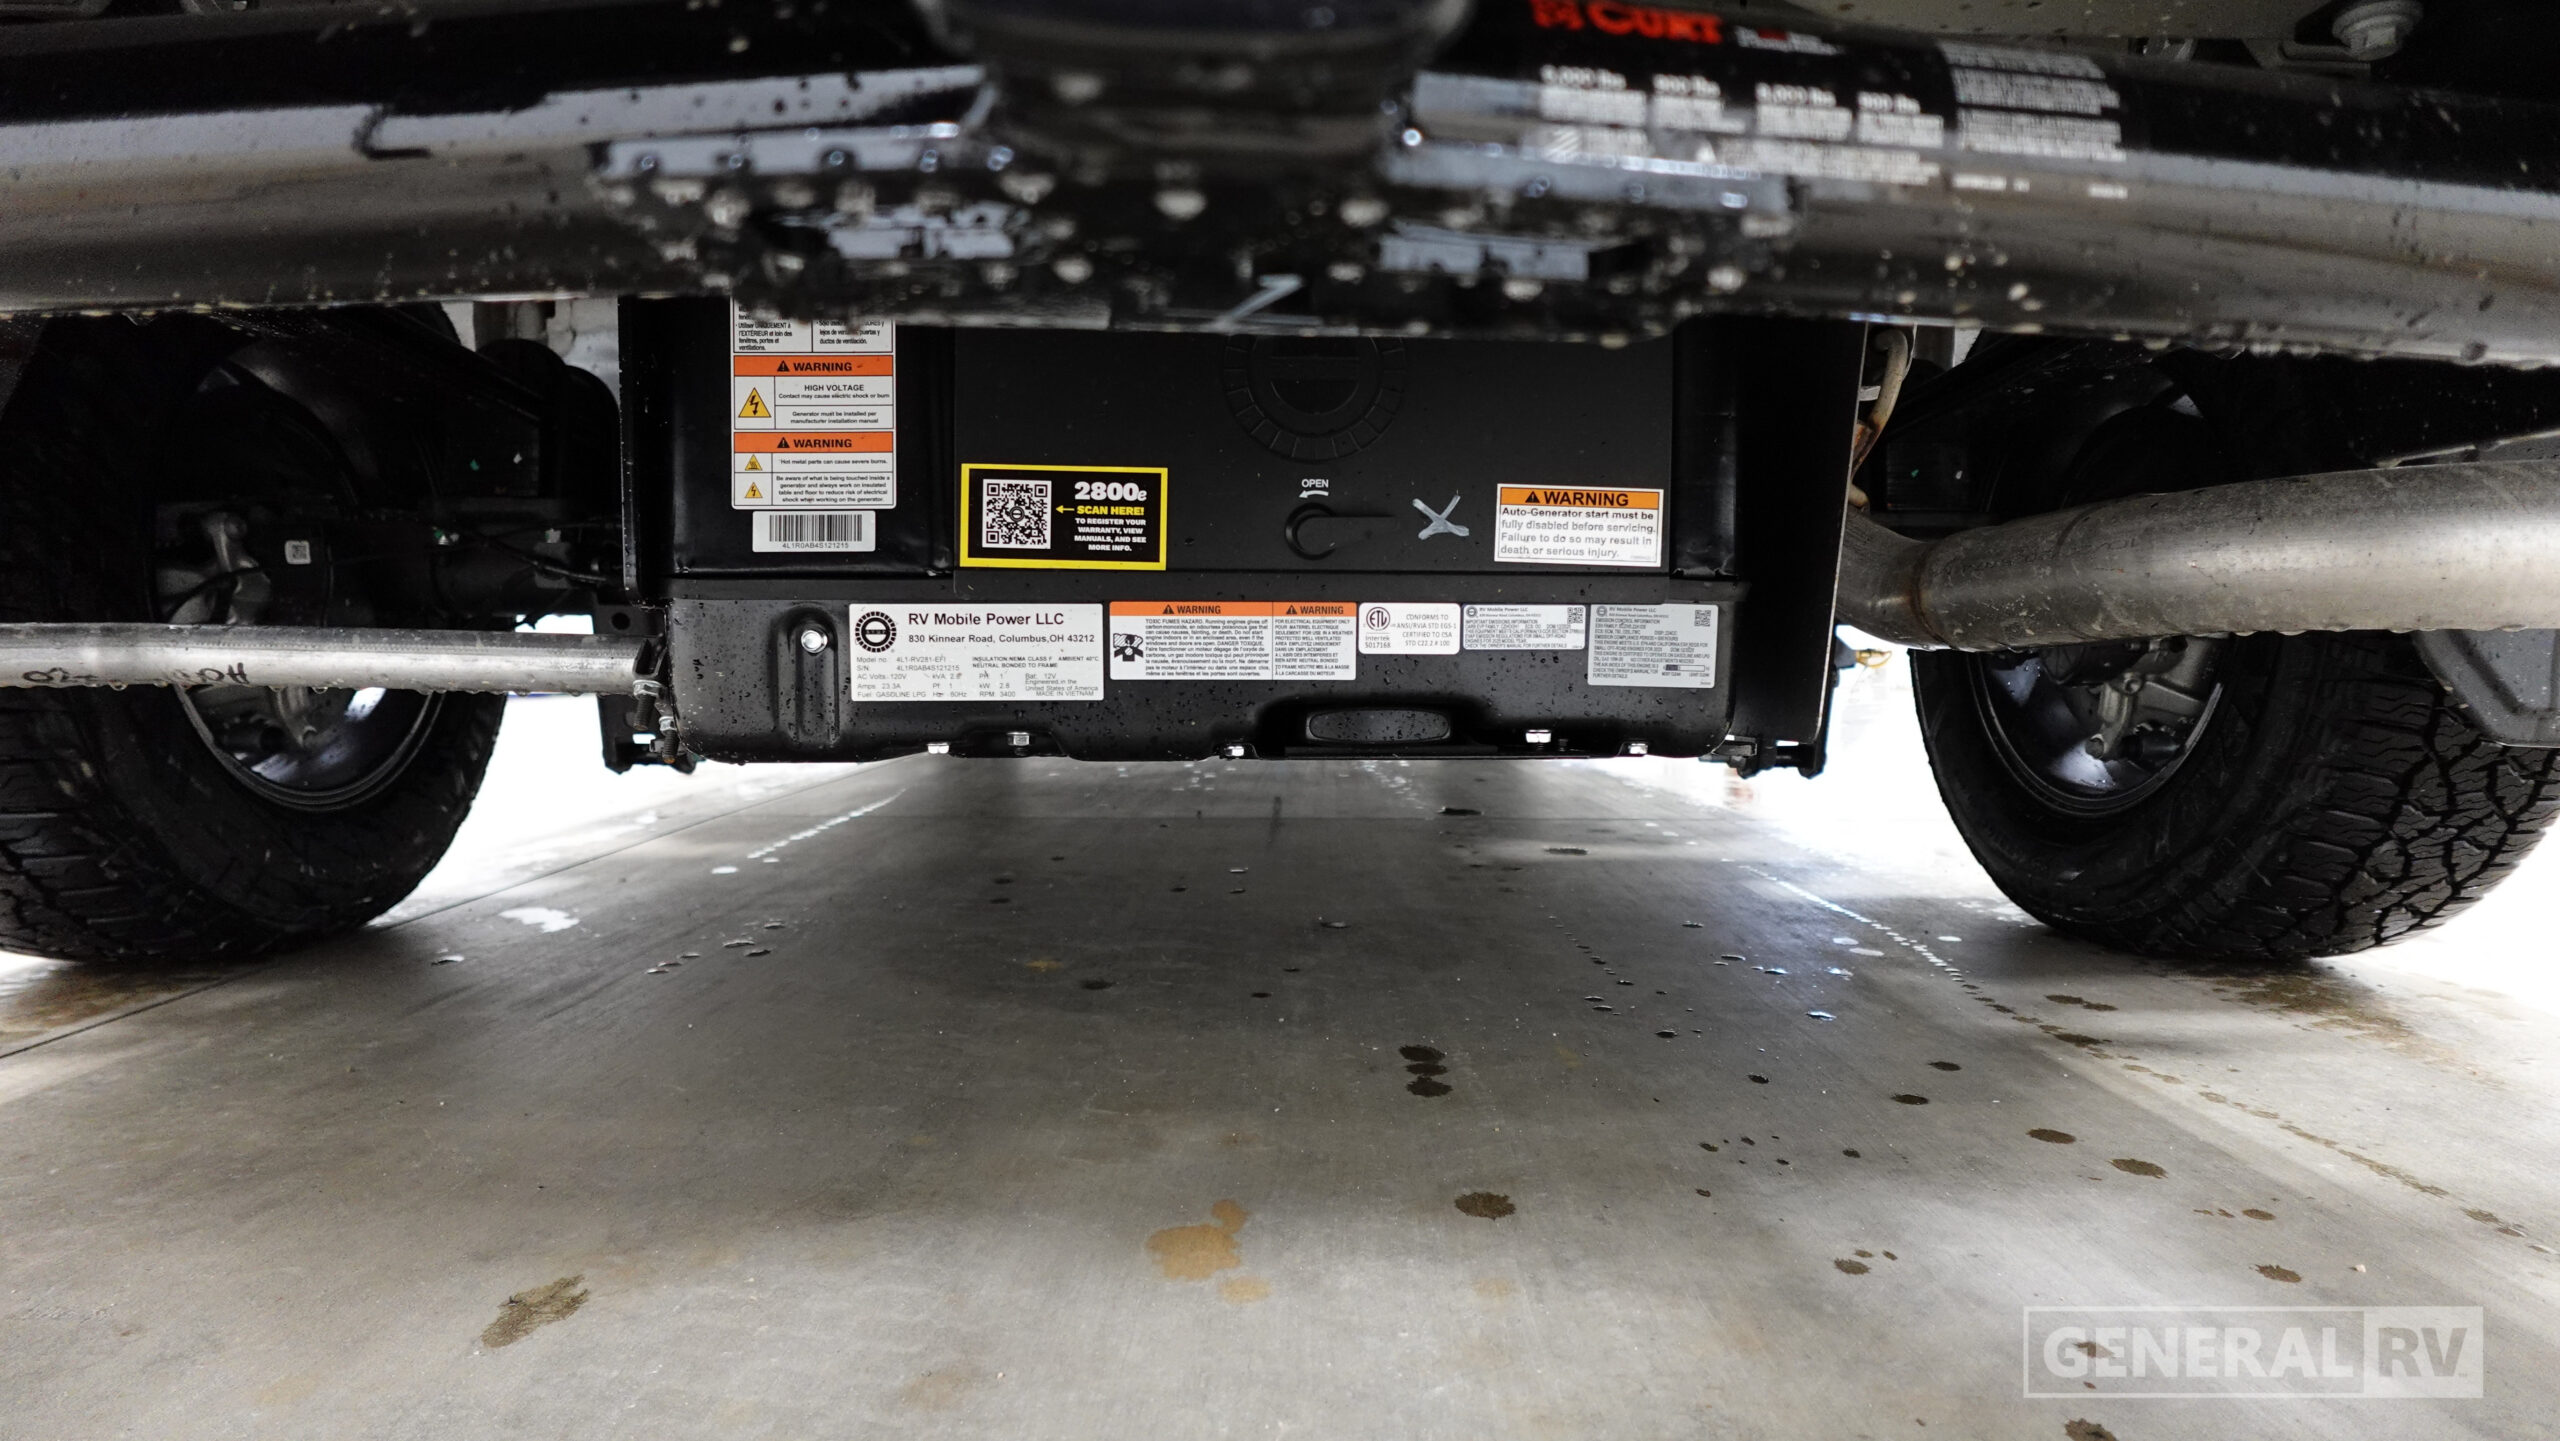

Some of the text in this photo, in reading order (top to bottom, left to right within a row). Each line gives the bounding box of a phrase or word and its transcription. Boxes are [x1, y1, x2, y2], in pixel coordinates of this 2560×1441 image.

[1588, 1, 1722, 44] CURT
[793, 362, 852, 371] WARNING
[793, 439, 852, 448] WARNING
[1301, 479, 1329, 488] OPEN
[1074, 481, 1147, 501] 2800e
[1544, 491, 1629, 506] WARNING
[1077, 505, 1144, 515] SCAN HERE!
[1502, 507, 1653, 520] Auto-Generator start must be
[1501, 520, 1655, 534] fully disabled before servicing.
[1074, 535, 1113, 543] MANUALS,
[1501, 532, 1651, 546] Failure to do so may result in
[1501, 546, 1529, 555] death
[1546, 547, 1584, 555] serious
[1588, 548, 1619, 559] injury.
[1177, 605, 1221, 614] WARNING
[1300, 606, 1344, 614] WARNING
[908, 613, 1064, 625] RV Mobile Power LLC
[908, 635, 925, 643] 830
[929, 635, 965, 643] Kinnear
[969, 635, 995, 643] Road,
